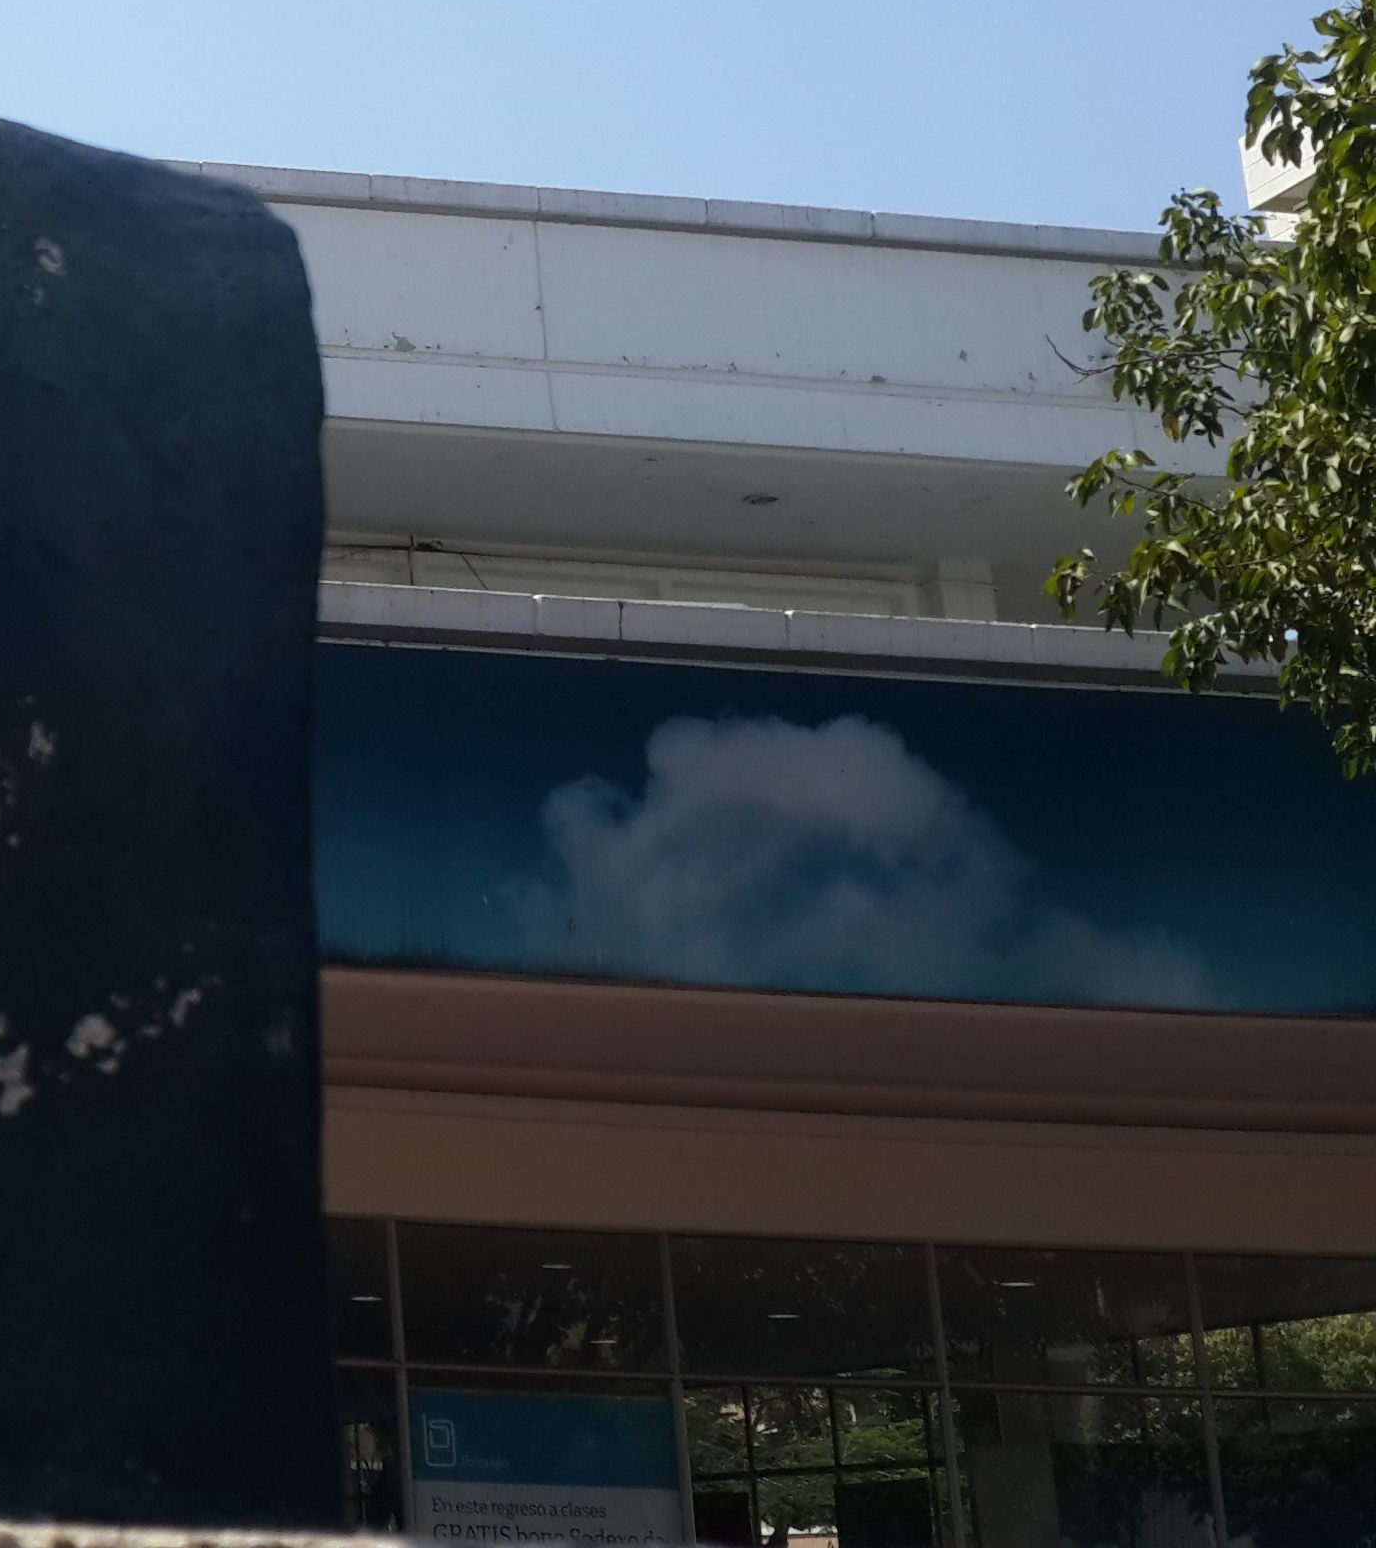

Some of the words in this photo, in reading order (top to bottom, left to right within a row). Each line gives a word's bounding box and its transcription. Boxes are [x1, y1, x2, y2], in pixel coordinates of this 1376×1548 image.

[432, 1497, 453, 1513] En
[455, 1500, 488, 1515] este
[491, 1501, 546, 1520] regreso
[549, 1504, 558, 1517] a
[561, 1502, 607, 1518] clases
